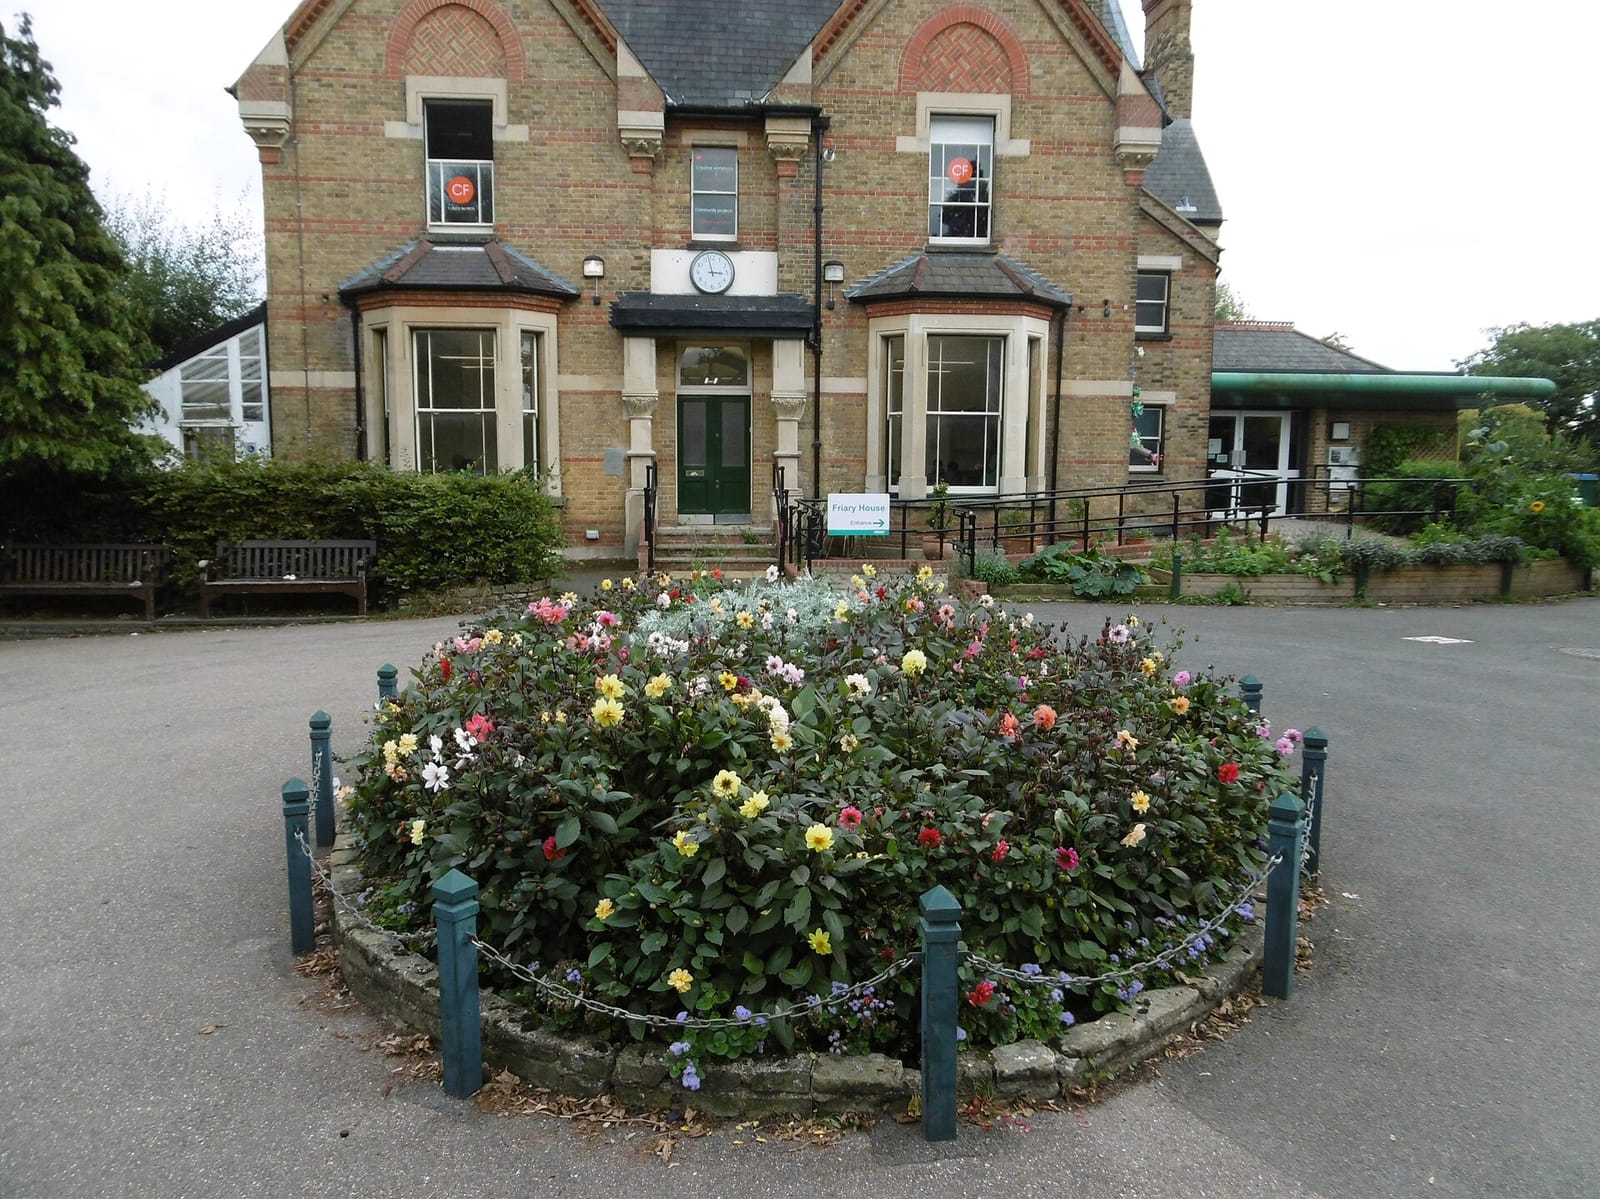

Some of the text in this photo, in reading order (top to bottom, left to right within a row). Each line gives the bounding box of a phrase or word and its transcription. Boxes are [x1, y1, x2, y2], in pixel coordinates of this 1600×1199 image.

[951, 164, 969, 176] CF
[451, 183, 469, 196] CF
[832, 503, 886, 513] Friary House
